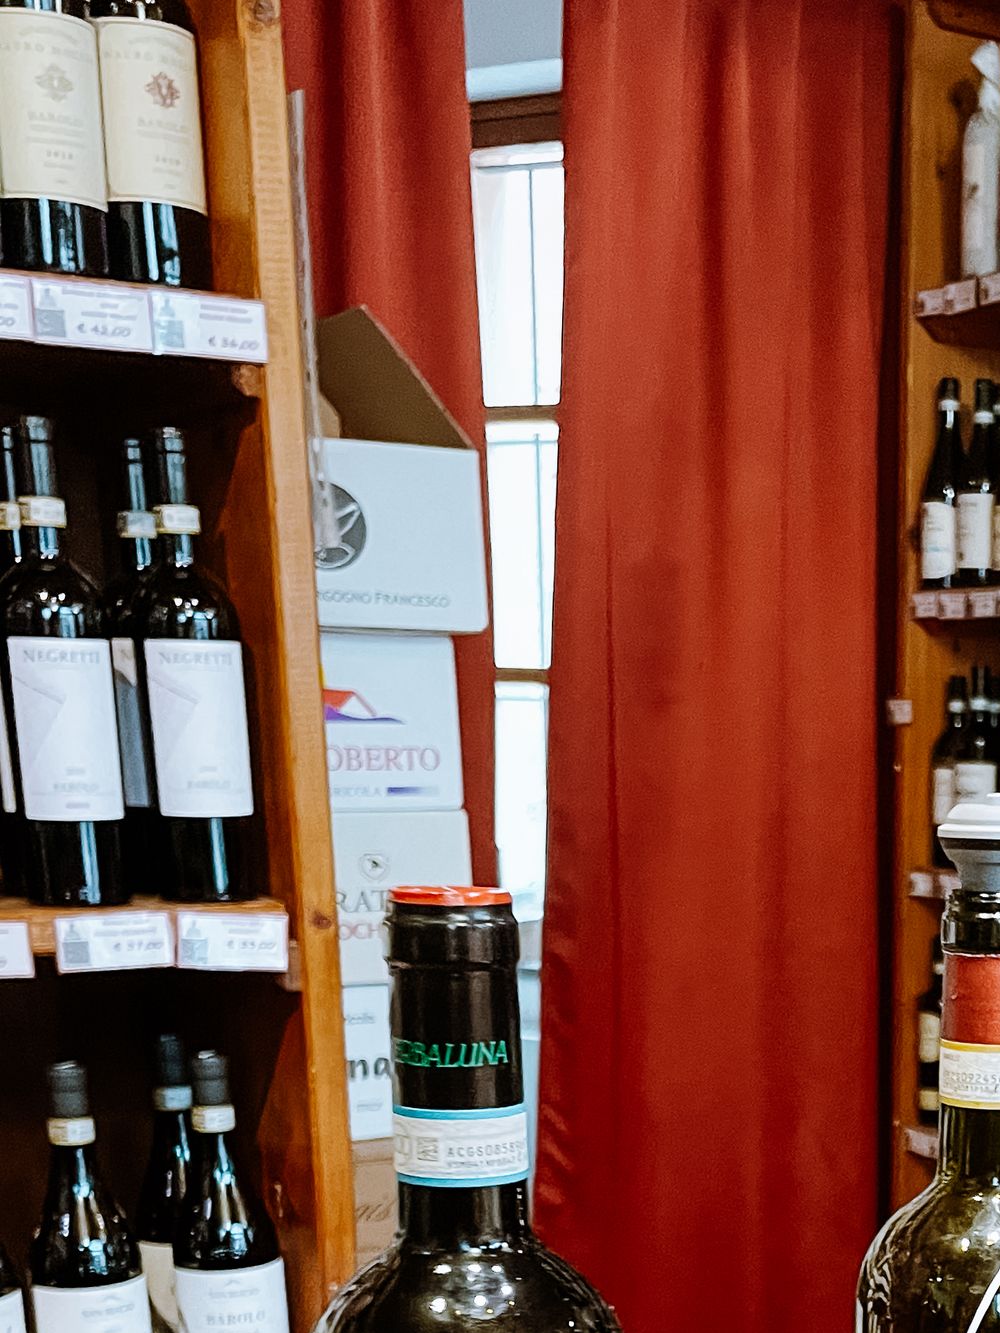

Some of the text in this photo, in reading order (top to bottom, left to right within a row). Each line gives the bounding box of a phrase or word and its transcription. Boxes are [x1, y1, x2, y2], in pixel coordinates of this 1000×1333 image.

[375, 592, 450, 608] FRANCESCO
[23, 648, 101, 665] NEGRETTI
[158, 651, 233, 666] NEGRETTI
[206, 1309, 267, 1326] BAROLO
